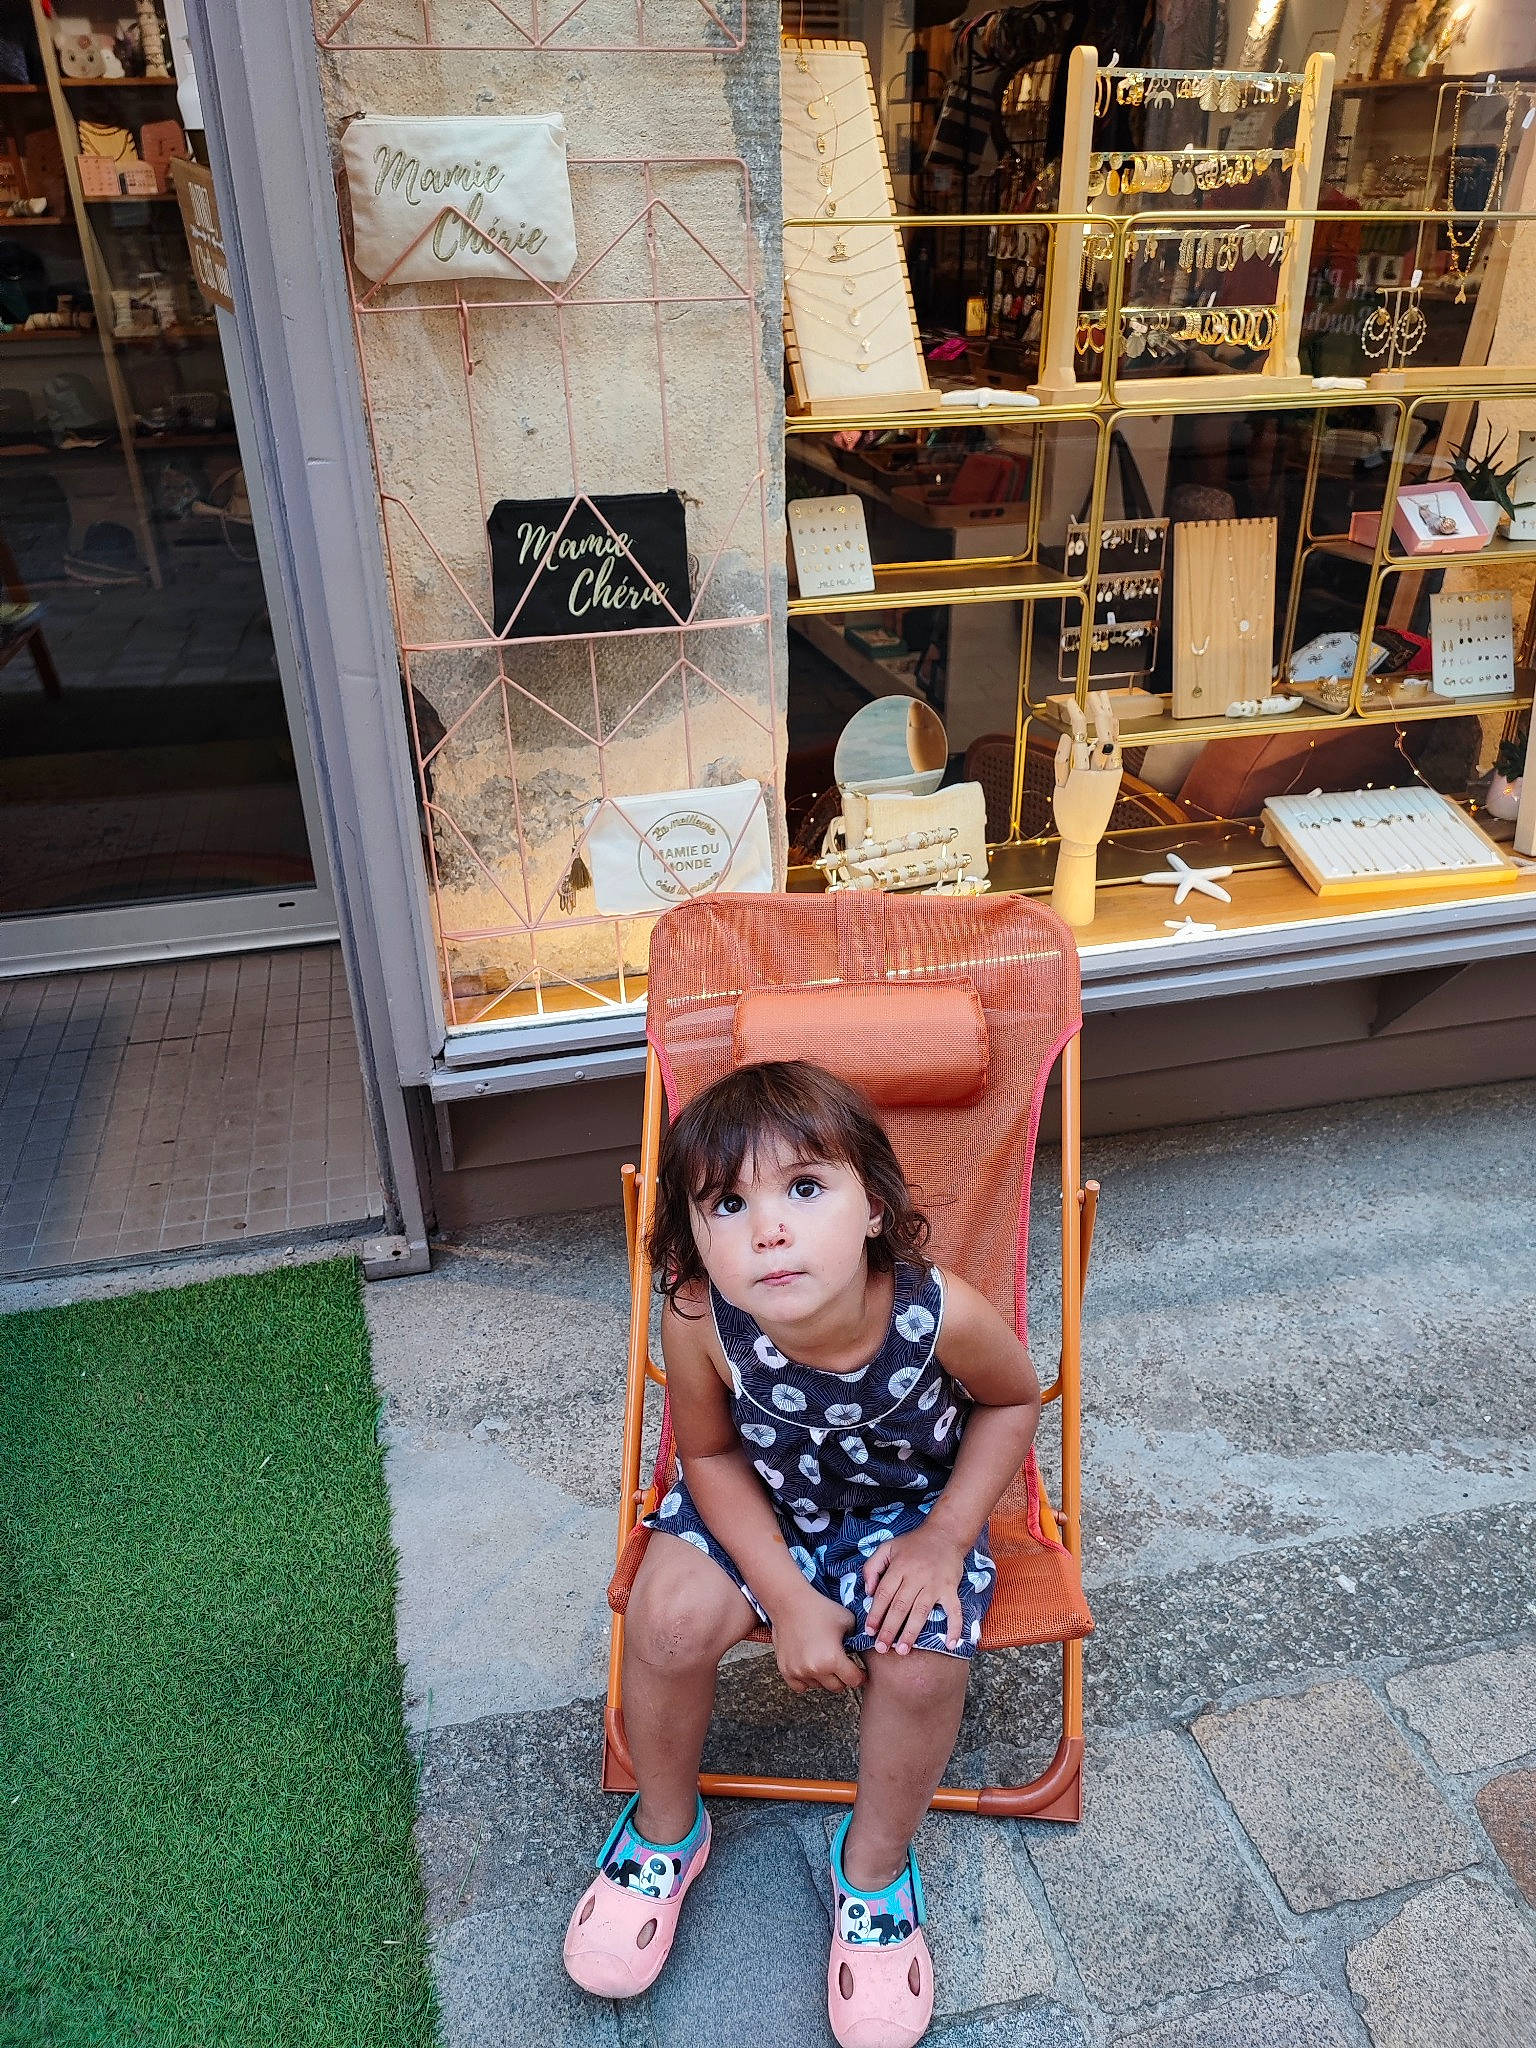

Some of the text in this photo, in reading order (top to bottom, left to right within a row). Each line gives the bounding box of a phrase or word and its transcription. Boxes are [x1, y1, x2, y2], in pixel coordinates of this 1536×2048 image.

[373, 144, 505, 206] Mamie
[432, 192, 549, 263] Chérie
[517, 522, 636, 571] Mamie
[568, 555, 670, 617] Chérie
[653, 842, 720, 861] MAMIE DU
